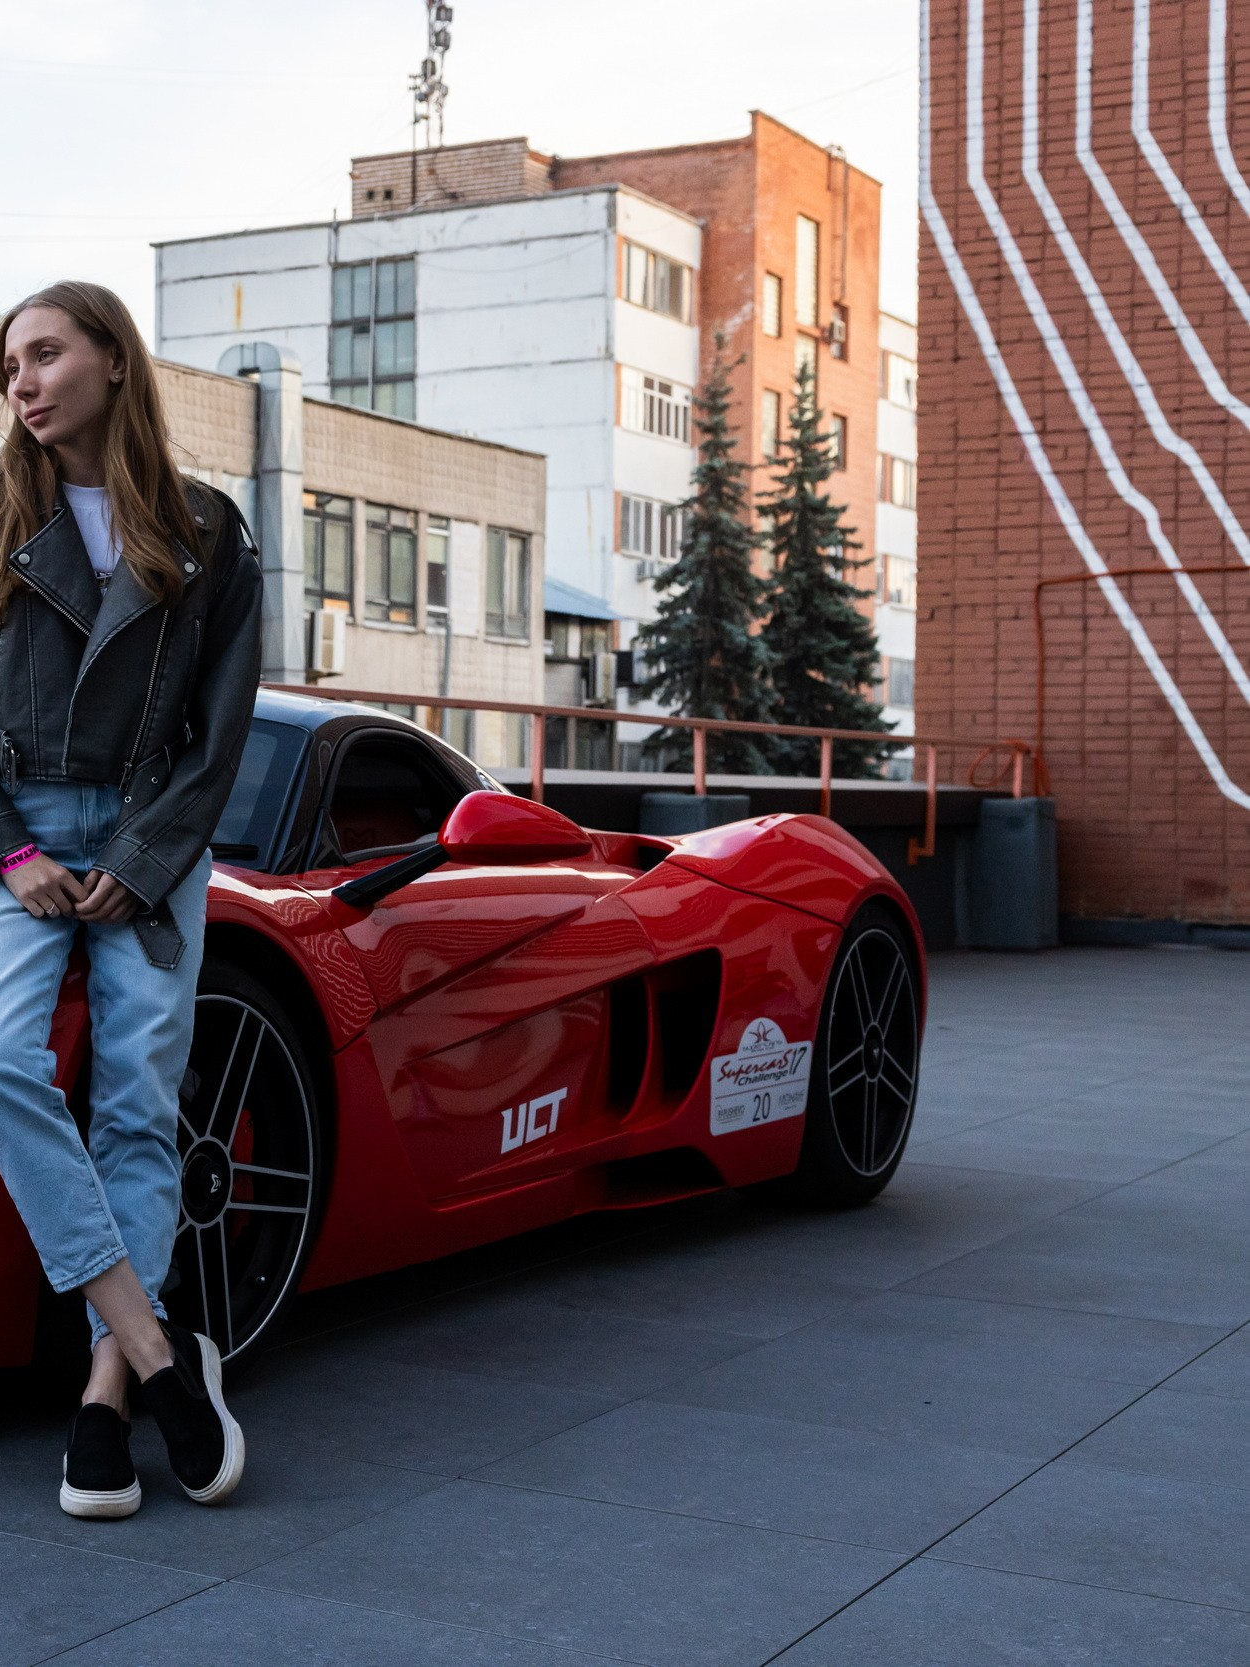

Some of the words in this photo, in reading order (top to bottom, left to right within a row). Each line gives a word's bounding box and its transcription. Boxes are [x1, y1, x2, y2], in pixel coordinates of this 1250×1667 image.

[790, 1046, 807, 1075] 17
[738, 1069, 789, 1087] Challenge
[752, 1092, 770, 1122] 20
